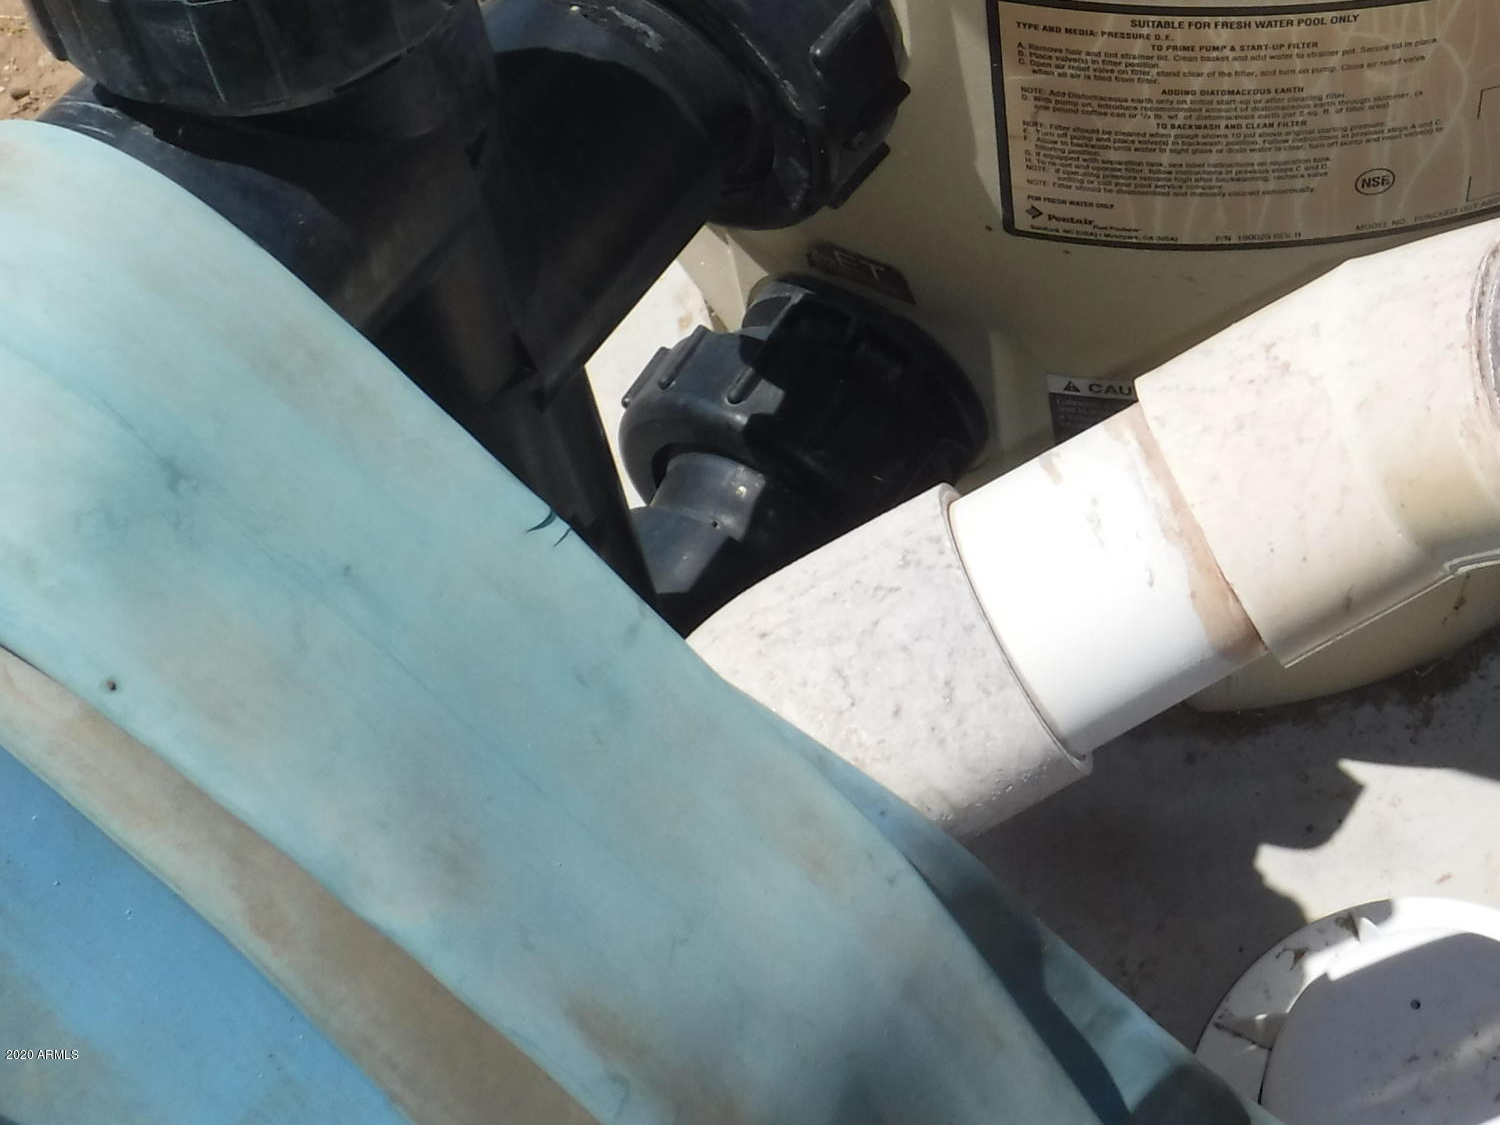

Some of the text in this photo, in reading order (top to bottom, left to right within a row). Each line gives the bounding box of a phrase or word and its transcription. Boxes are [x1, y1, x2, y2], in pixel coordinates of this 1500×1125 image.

[1130, 13, 1360, 30] SUITABLE FOR FRESH WATER POOL ONLY
[1016, 20, 1040, 32] TYPE
[1042, 24, 1062, 35] AND
[1064, 27, 1098, 37] MEDIA:
[1101, 30, 1152, 41] PRESSURE
[1151, 41, 1319, 53] TO PRIME PUMP & START-UP FILTER
[1161, 86, 1304, 96] ADDING DIATOMACEOUS EARTH
[1156, 120, 1307, 131] TO BACKWASH AND CLEAN FILTER
[1360, 175, 1391, 189] NSF
[1027, 194, 1042, 203] FOR
[1069, 198, 1094, 208] WATER
[1095, 200, 1114, 209] ONLY
[1047, 214, 1094, 226] Pentair
